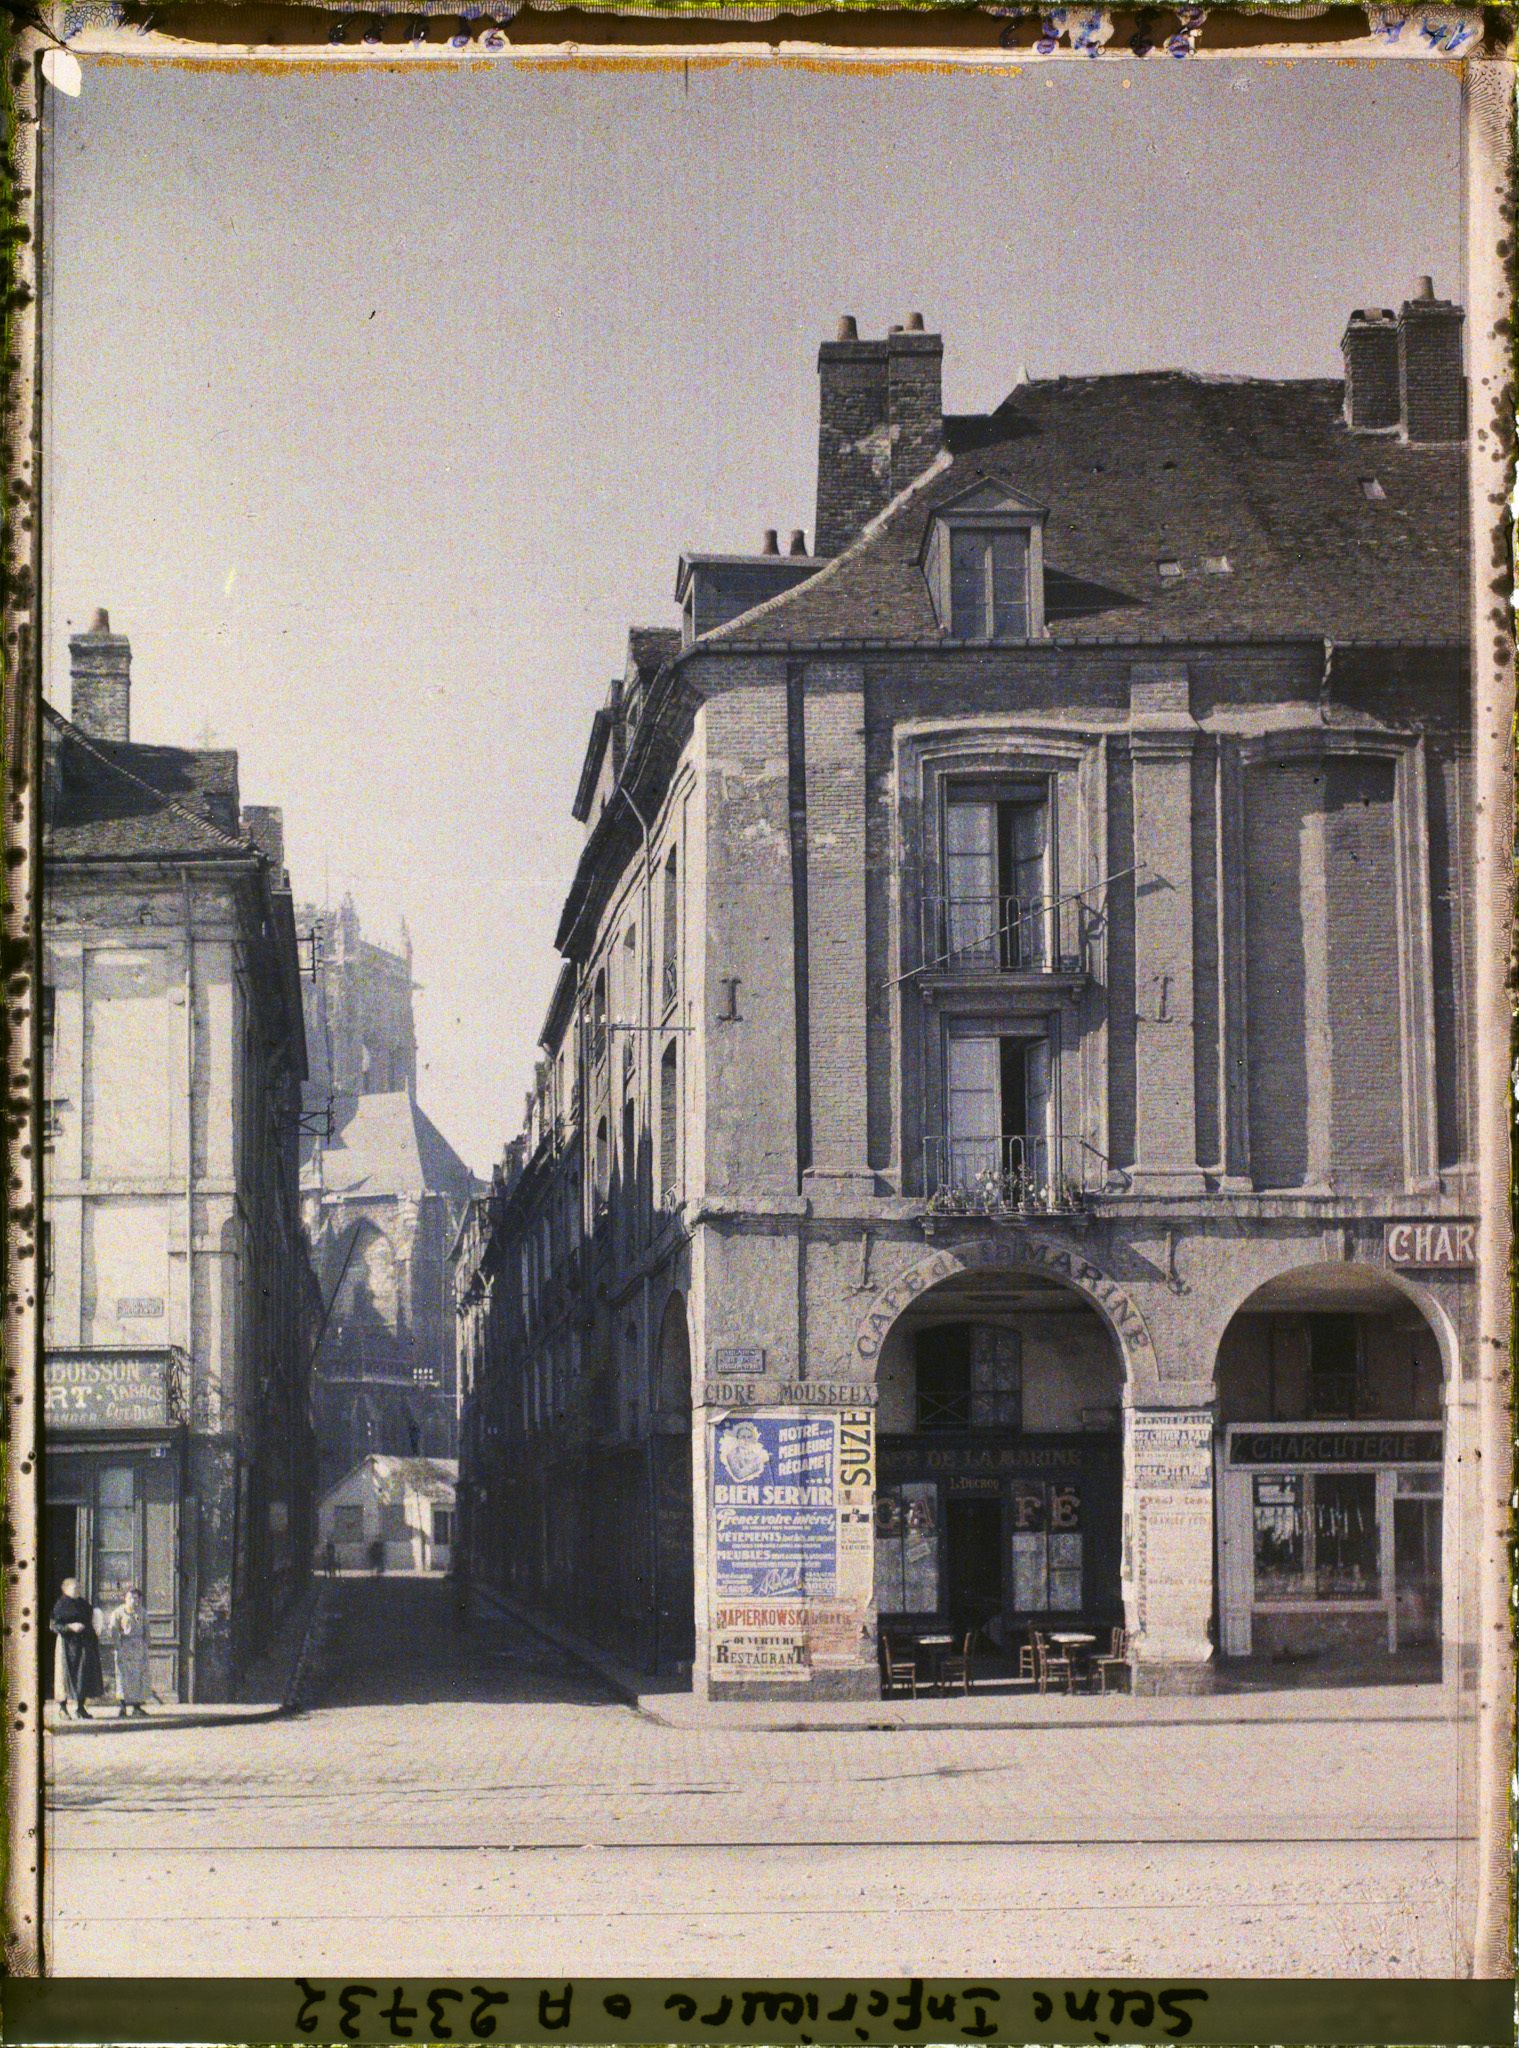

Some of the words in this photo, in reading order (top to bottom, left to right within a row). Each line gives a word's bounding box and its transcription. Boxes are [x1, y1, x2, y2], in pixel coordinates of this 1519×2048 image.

[1025, 1242, 1152, 1352] MARINE
[704, 1384, 756, 1401] CIDRE
[779, 1384, 872, 1404] MOUSSEUX
[778, 1438, 833, 1460] MEILLEURE
[840, 1411, 872, 1486] SUZE
[1251, 1436, 1416, 1459] CHARCUTERIE
[714, 1485, 759, 1506] BIEN
[762, 1485, 833, 1506] SERVIR
[717, 1550, 771, 1561] MEUBLES
[294, 1977, 510, 2039] 23732
[538, 1982, 574, 2030] A
[1033, 1986, 1209, 2044] Seine
